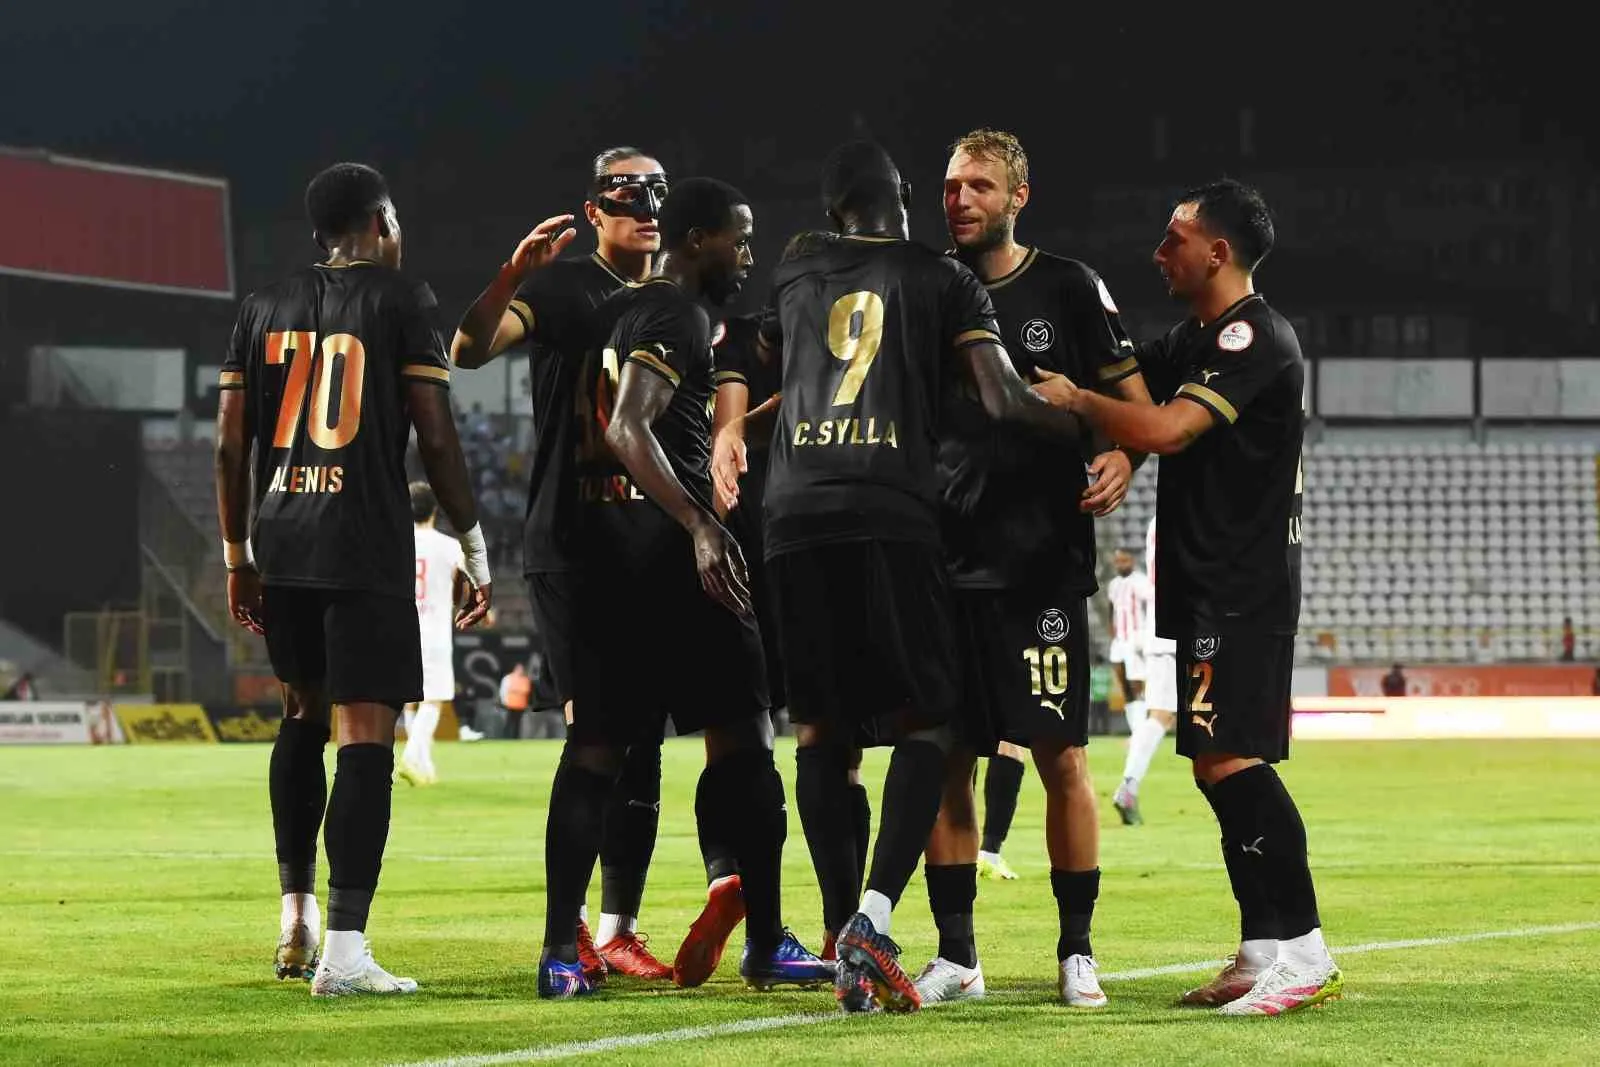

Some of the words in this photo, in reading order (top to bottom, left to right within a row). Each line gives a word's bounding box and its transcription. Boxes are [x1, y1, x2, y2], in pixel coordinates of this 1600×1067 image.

[828, 291, 884, 406] 9
[265, 331, 366, 450] 70
[793, 417, 898, 449] C.SYLLA
[268, 466, 344, 493] ALENIS
[1023, 646, 1067, 695] 10
[1186, 662, 1213, 711] 2
